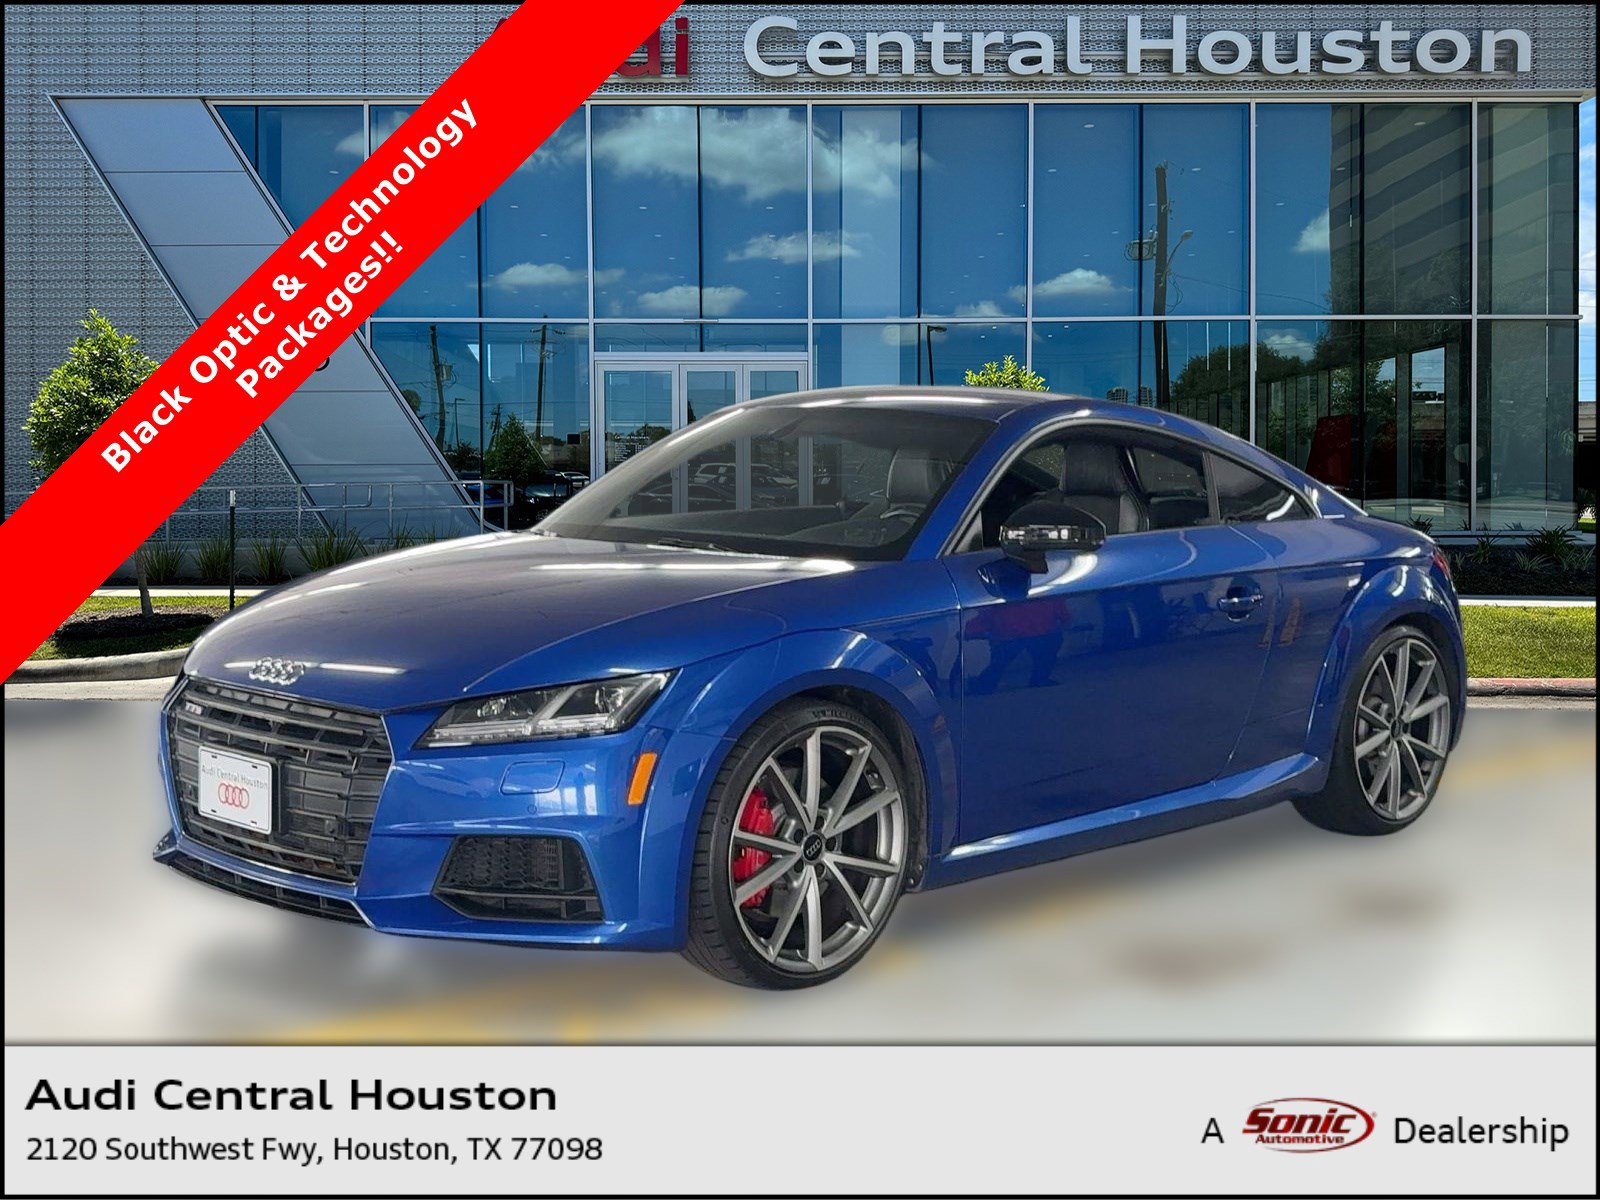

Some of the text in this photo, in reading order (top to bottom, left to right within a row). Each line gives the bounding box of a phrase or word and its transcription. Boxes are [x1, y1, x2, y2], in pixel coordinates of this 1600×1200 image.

[743, 15, 1093, 77] Central
[1126, 14, 1532, 75] Houston
[216, 768, 240, 782] Central
[240, 773, 268, 789] Houston
